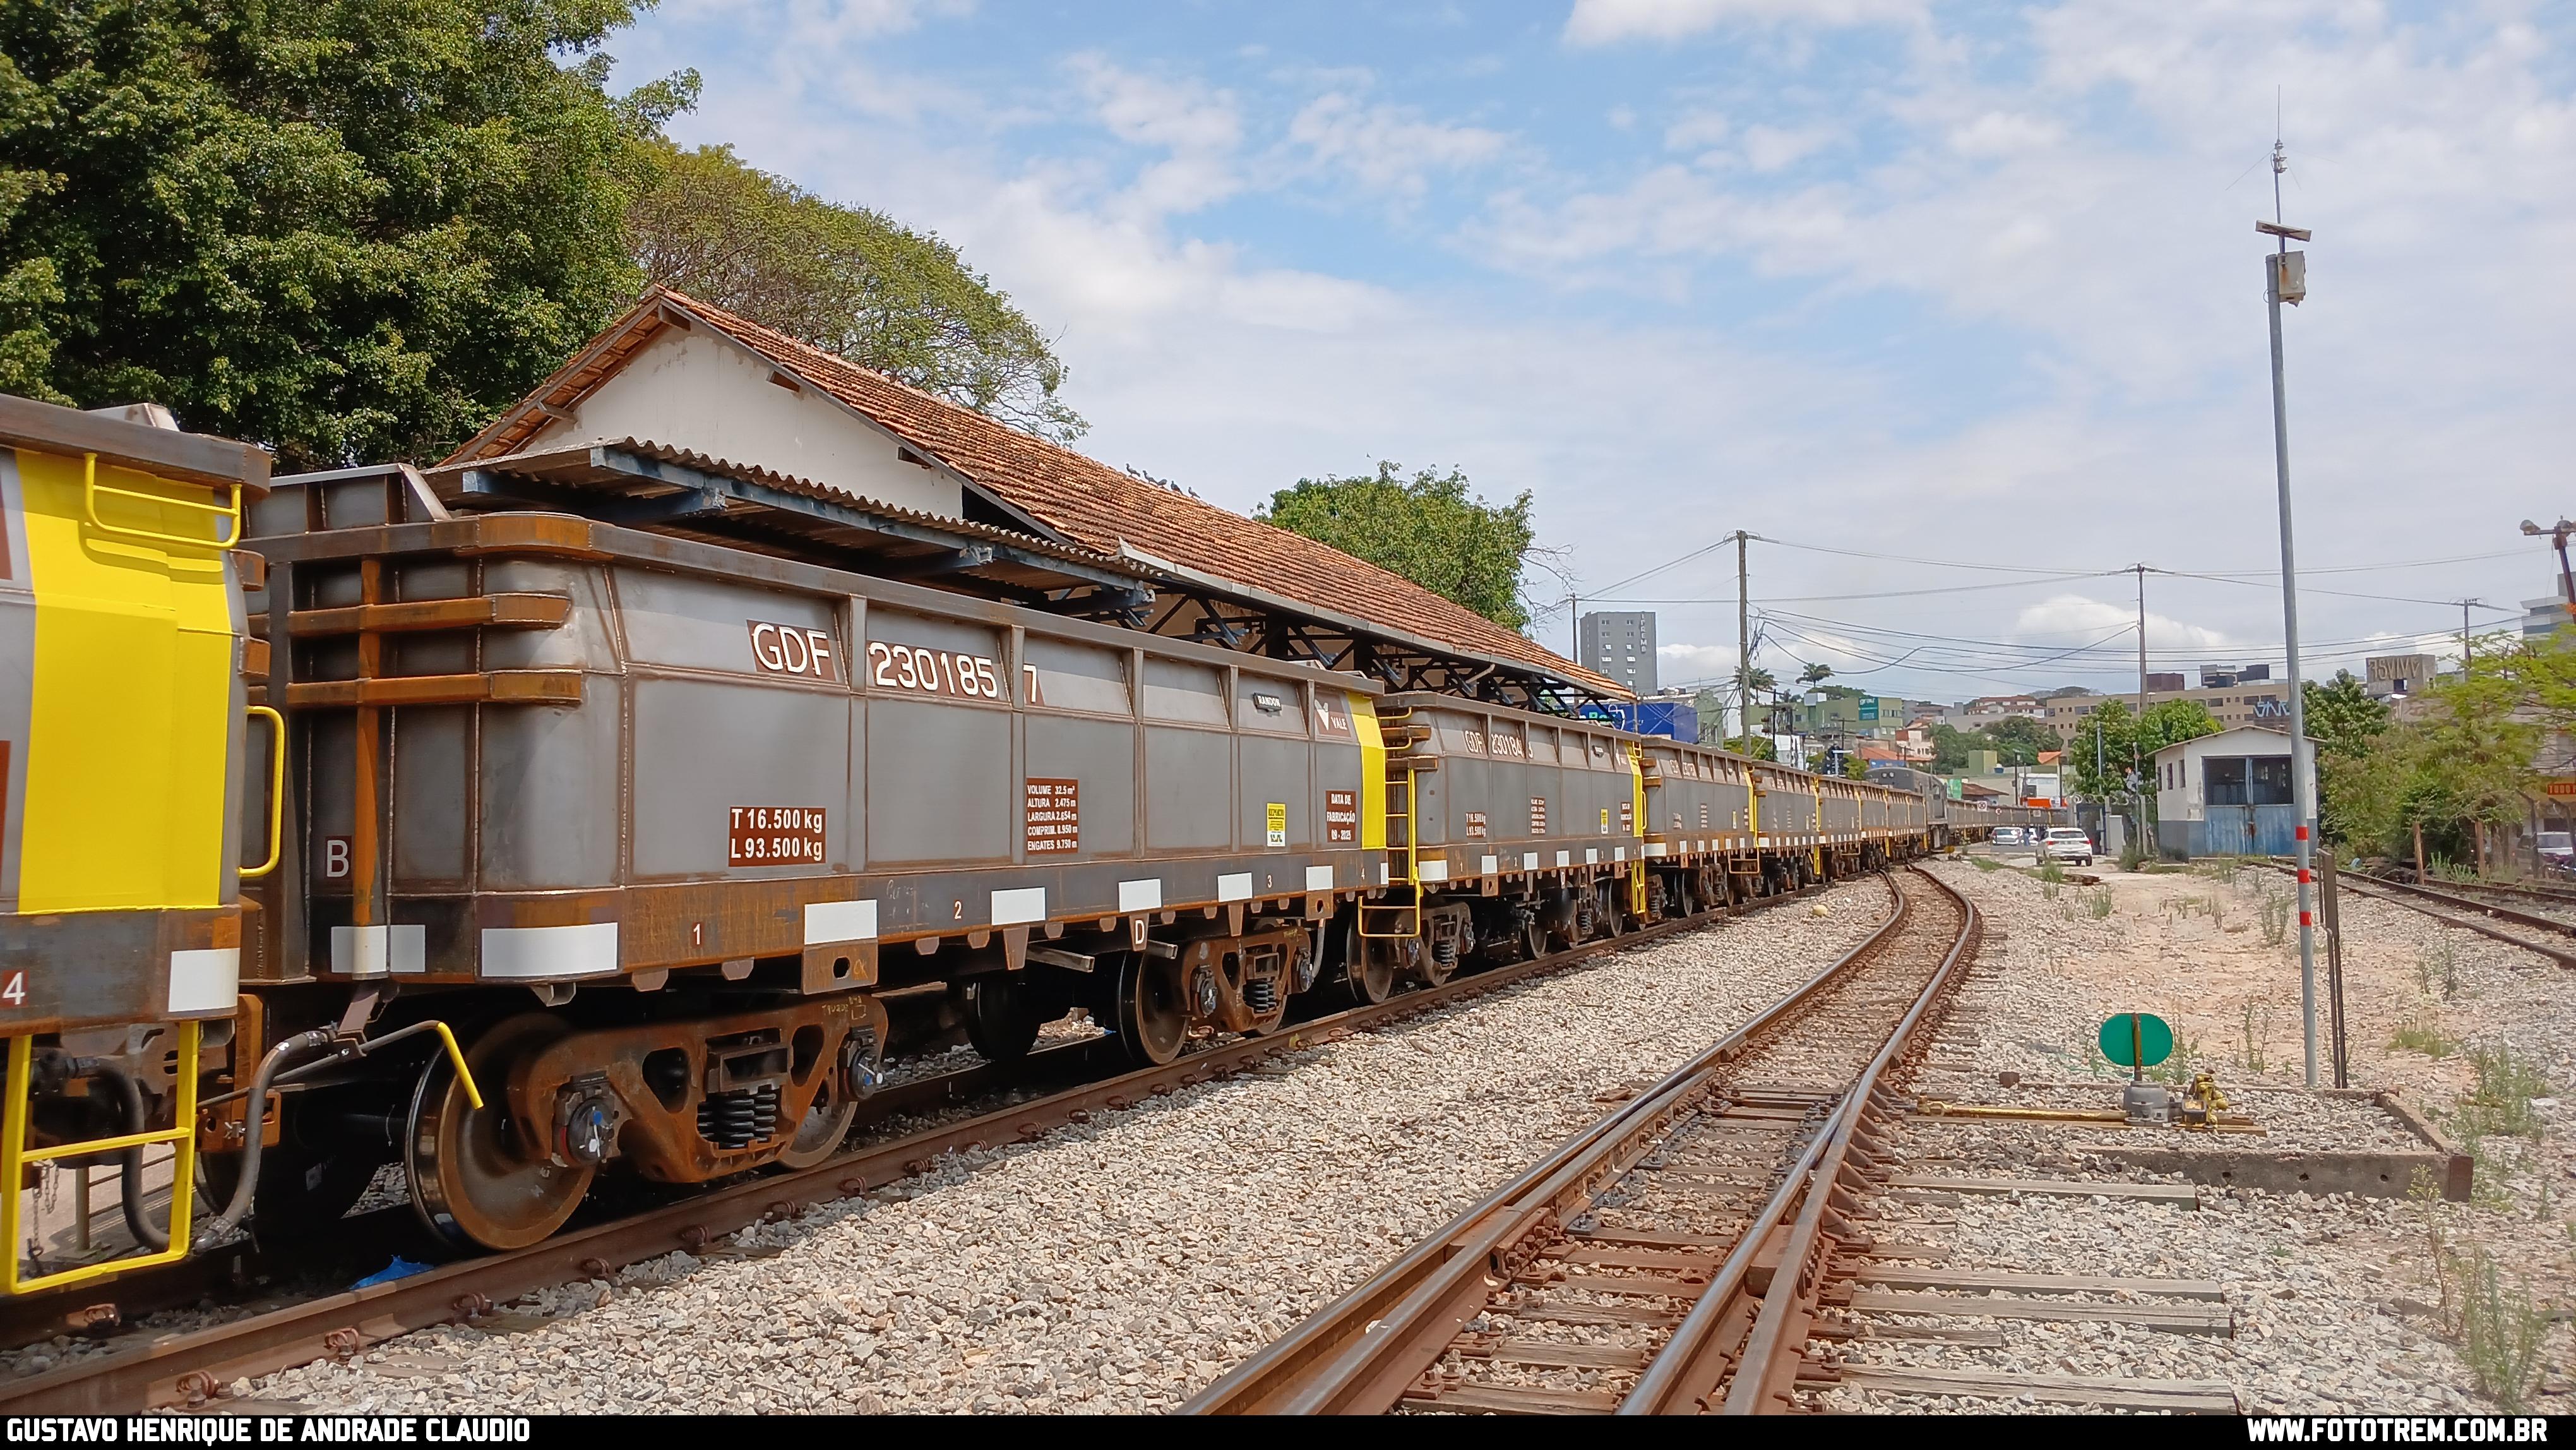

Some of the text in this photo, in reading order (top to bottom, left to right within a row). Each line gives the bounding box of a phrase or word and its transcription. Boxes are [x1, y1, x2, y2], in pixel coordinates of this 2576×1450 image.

[753, 623, 1037, 703] GDF 230185 7
[1257, 695, 1281, 707] RANDON
[1330, 716, 1347, 730] VALE
[1465, 730, 1482, 754] GDF
[1027, 785, 1052, 794] VOLUME
[1055, 786, 1067, 794] 32.5
[1027, 798, 1051, 808] ALTURA
[1055, 798, 1070, 807] 2.475
[1331, 793, 1352, 805] DATA DE
[731, 808, 822, 834] T 16.500 kg
[1027, 811, 1056, 822] LARGURA
[1056, 811, 1071, 821] 2.654
[1327, 810, 1356, 825] FABRICAÇÃO
[1028, 825, 1056, 836] COMPRIM.
[731, 837, 822, 861] L 93.500 kg
[1028, 840, 1055, 851] ENGATES
[327, 839, 349, 877] B
[1361, 868, 1366, 880] 4
[1267, 875, 1272, 888] 3
[954, 901, 962, 920] 2
[693, 923, 700, 945] 1
[1135, 920, 1145, 945] D
[2, 972, 26, 1005] 4
